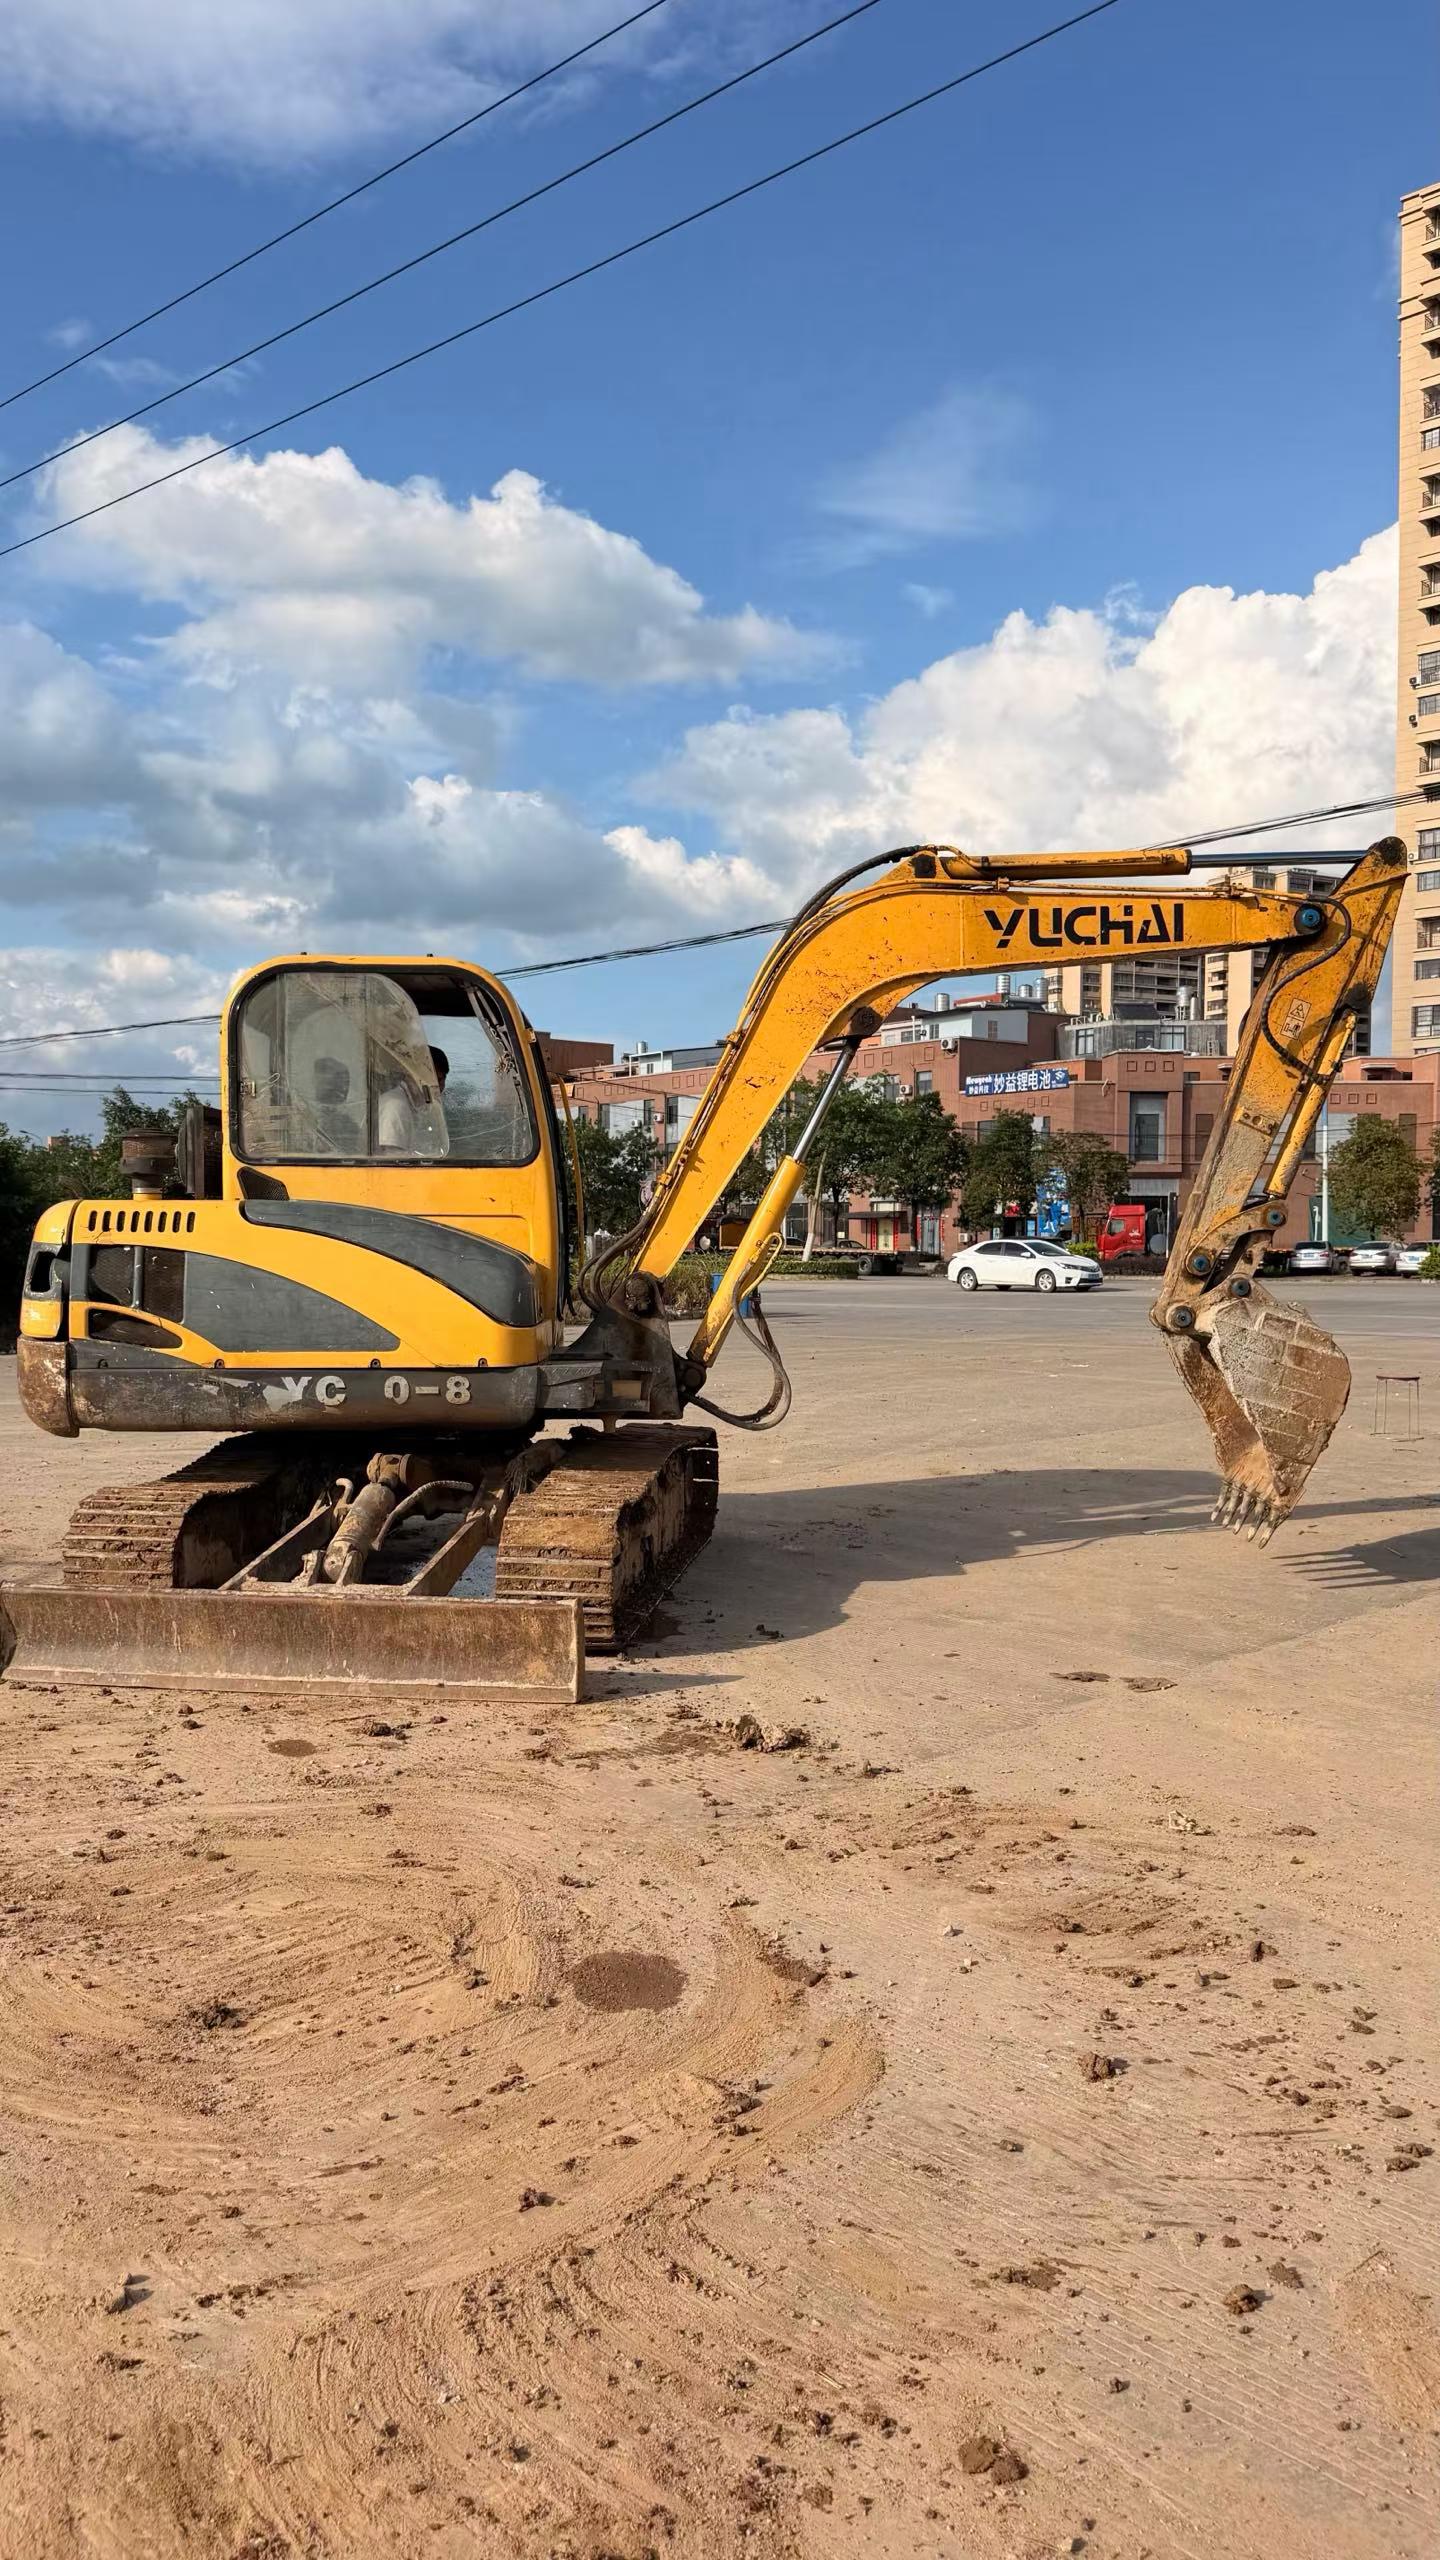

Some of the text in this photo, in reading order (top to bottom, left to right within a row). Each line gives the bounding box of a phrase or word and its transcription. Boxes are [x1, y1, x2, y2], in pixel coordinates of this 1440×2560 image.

[983, 902, 1184, 949] YUCHAI
[993, 1069, 1051, 1094] 妙益锂电池
